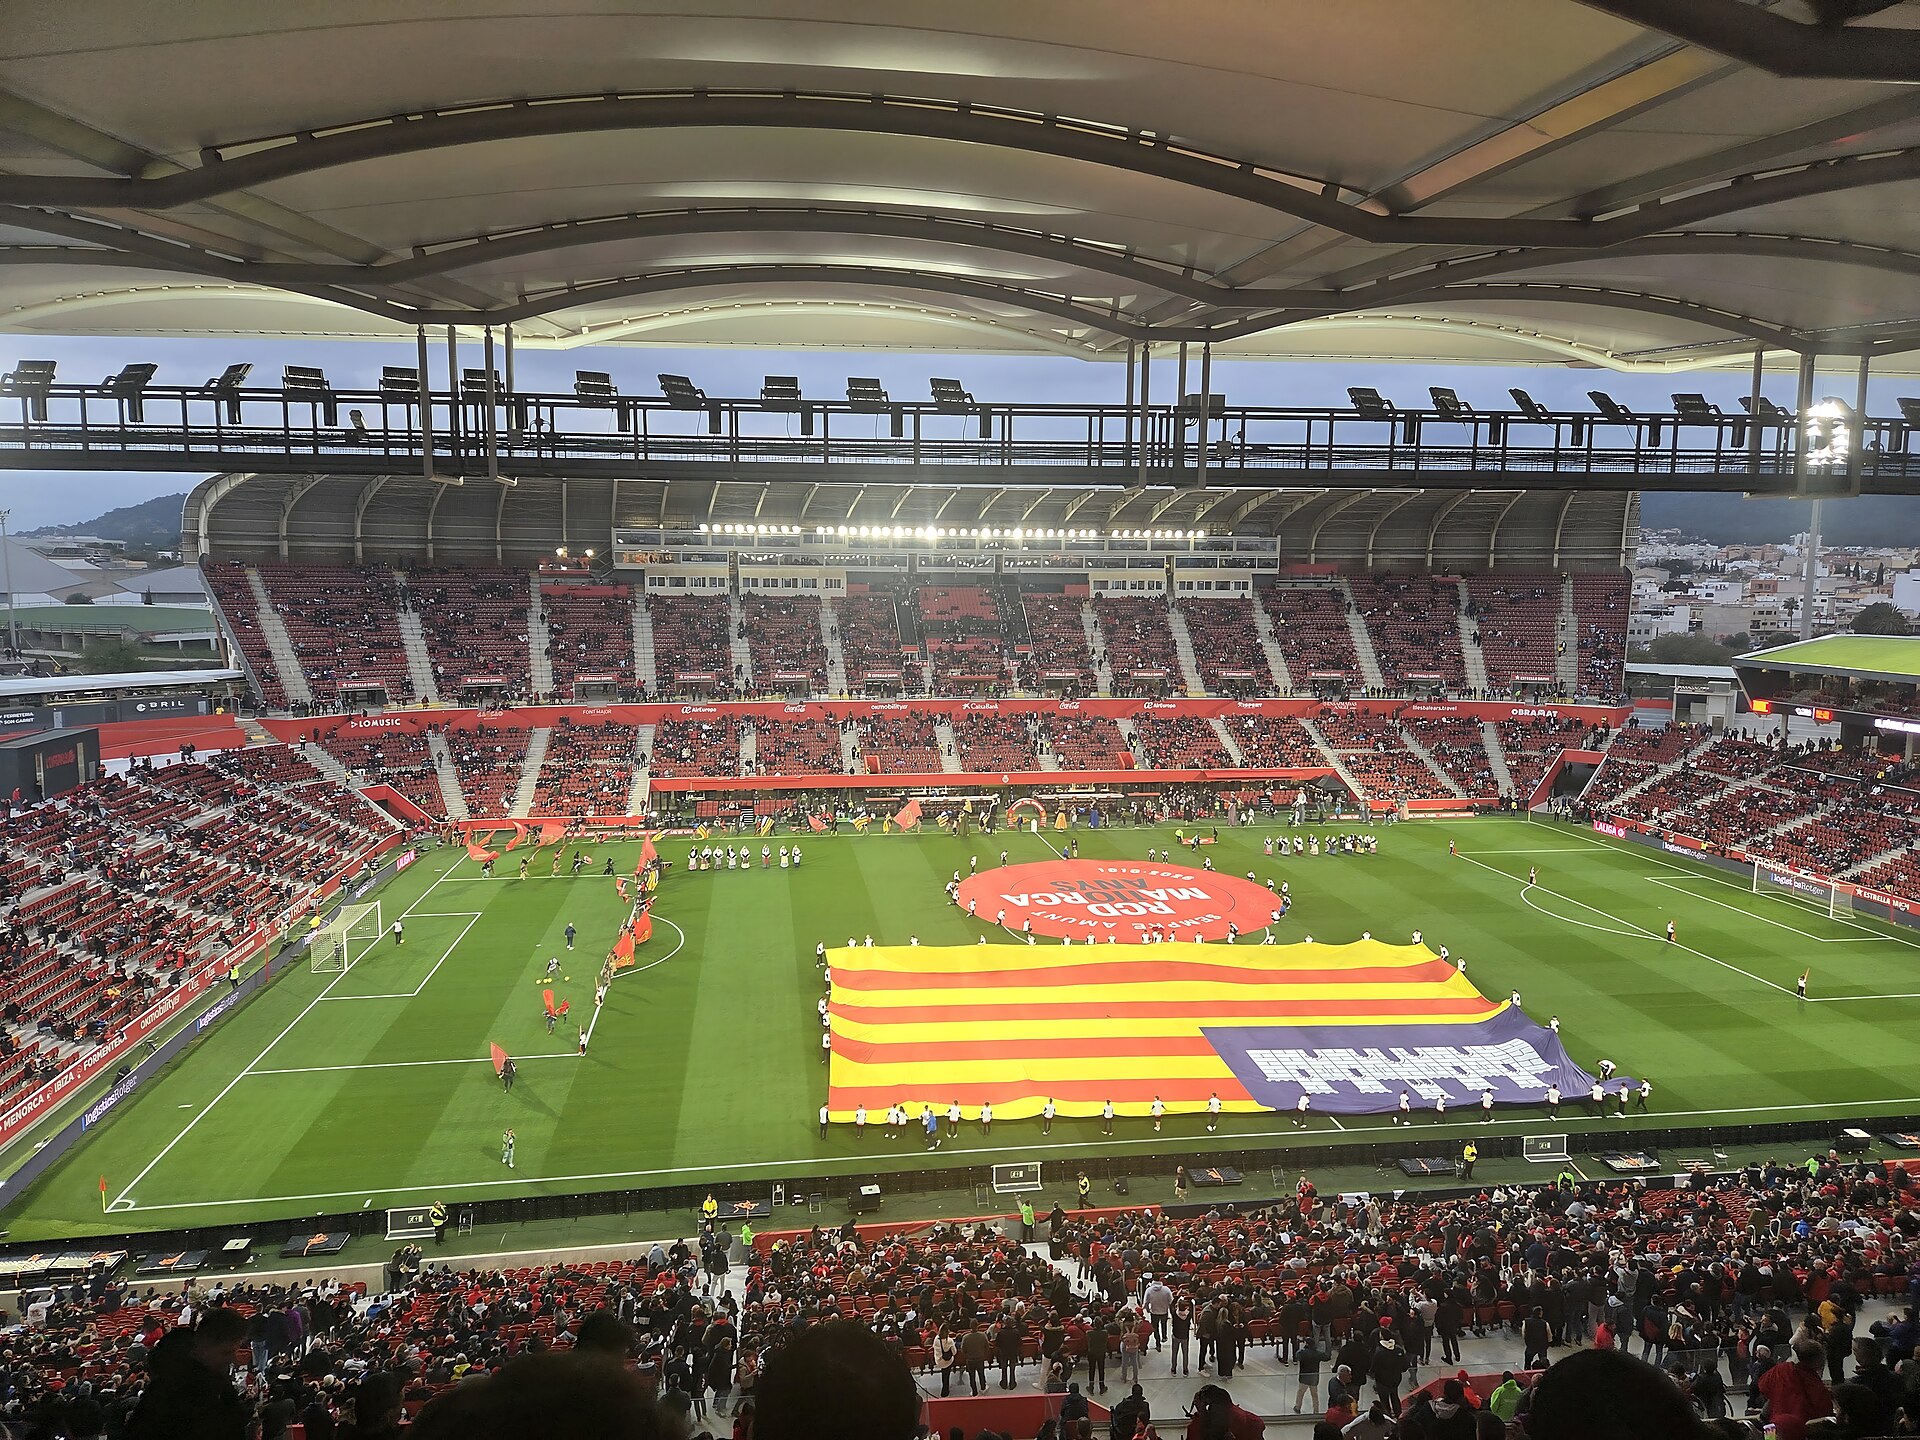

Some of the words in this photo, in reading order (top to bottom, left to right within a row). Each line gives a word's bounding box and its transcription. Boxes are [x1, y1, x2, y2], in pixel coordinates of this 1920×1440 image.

[1511, 708, 1559, 718] OBRAMAT
[359, 718, 401, 728] LOMUSIC
[1595, 821, 1617, 836] LALIGA
[1050, 877, 1148, 892] ANYS
[1863, 891, 1891, 905] ESTRELLA
[1087, 901, 1176, 917] RCD
[3, 1094, 45, 1131] MENORCA
[54, 1071, 75, 1092] IBIZA
[84, 1075, 138, 1126] logisticsRotger
